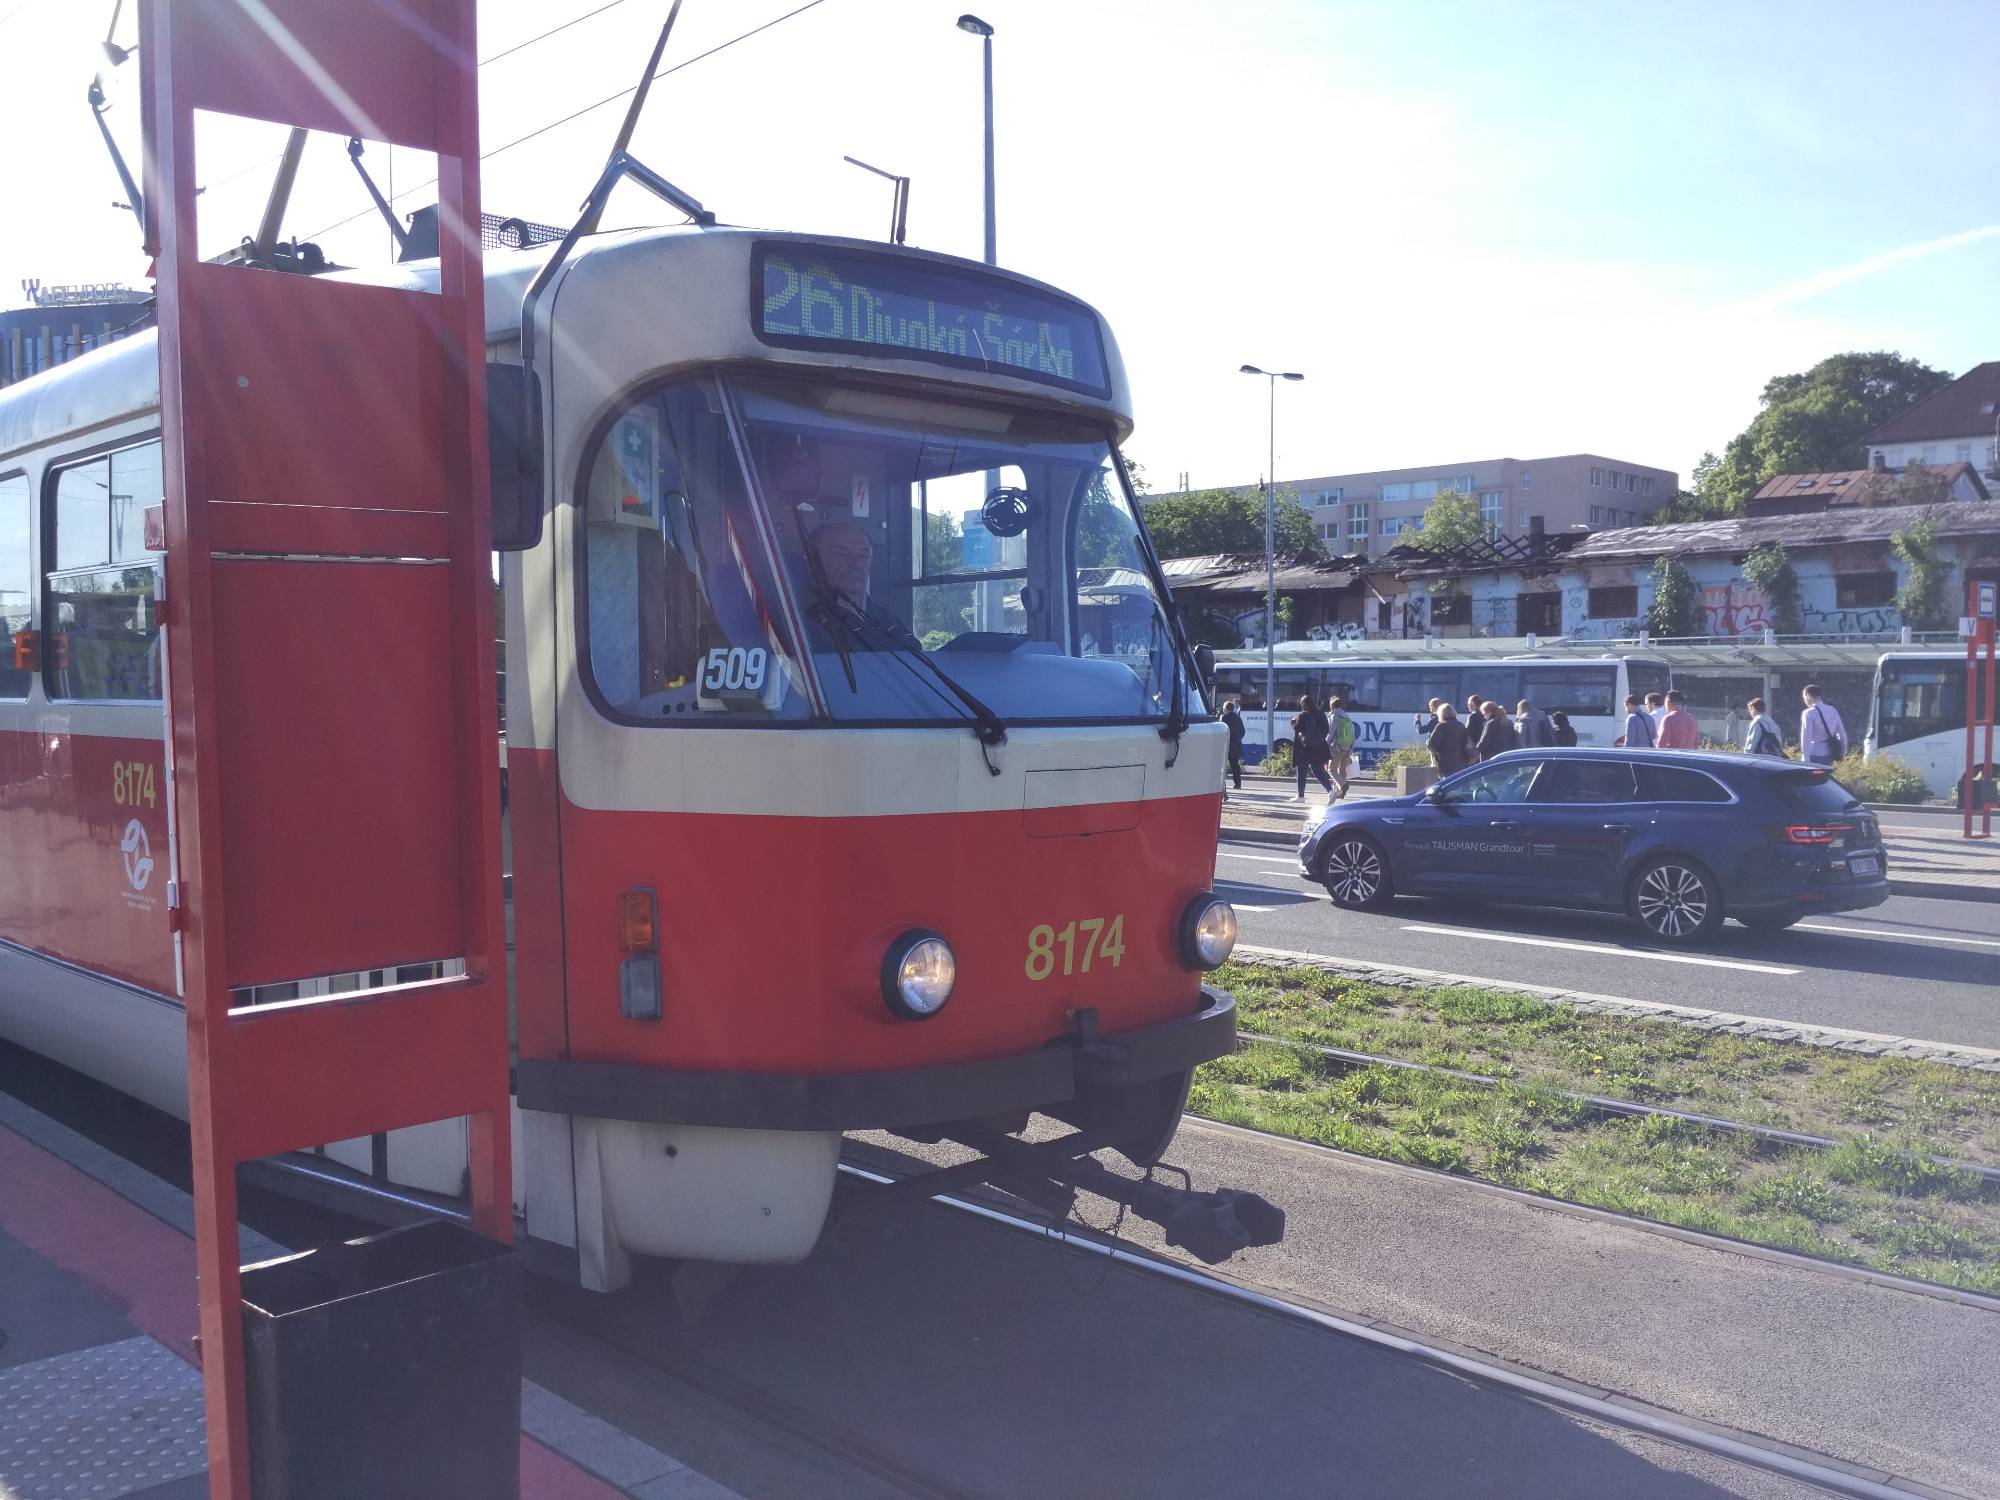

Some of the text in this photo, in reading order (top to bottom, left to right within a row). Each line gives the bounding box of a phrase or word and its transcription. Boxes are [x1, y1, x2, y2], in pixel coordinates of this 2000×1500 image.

[763, 256, 844, 339] 26
[705, 647, 767, 690] 509
[113, 760, 157, 809] 8174
[1431, 841, 1478, 851] TALISMAN
[1479, 841, 1525, 853] Grandtour
[1025, 913, 1126, 981] 8174
